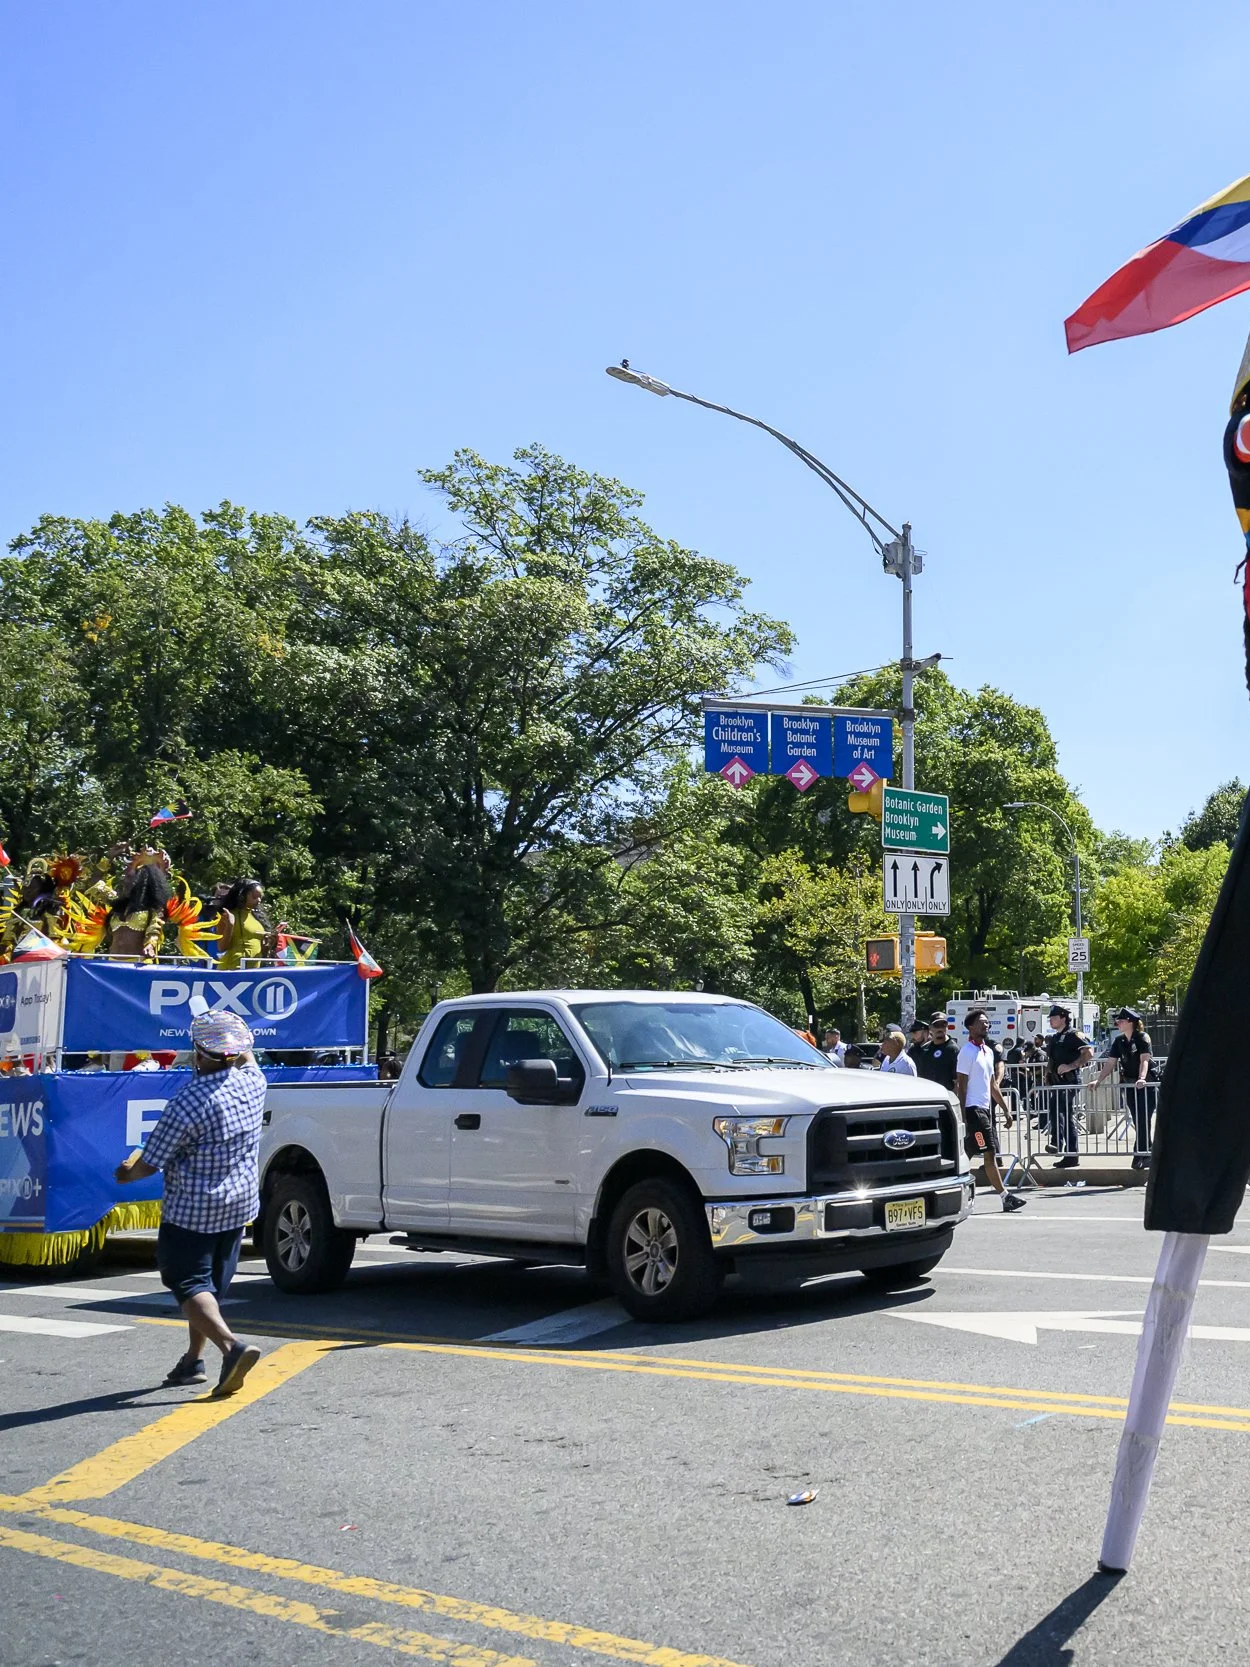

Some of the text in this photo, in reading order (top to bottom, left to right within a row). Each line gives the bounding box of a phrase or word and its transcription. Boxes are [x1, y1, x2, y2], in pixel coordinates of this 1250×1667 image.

[720, 715, 754, 728] Brooklyn
[783, 718, 819, 734] Brooklyn
[846, 721, 881, 735] Brooklyn
[713, 727, 761, 742] Children's
[787, 731, 816, 744] Botanic
[847, 734, 880, 746] Museum
[720, 743, 754, 754] Museum
[787, 745, 817, 757] Garden
[853, 748, 875, 759] of Art
[885, 796, 943, 815] Botanic Garden
[885, 811, 919, 828] Brooklyn
[885, 827, 917, 840] Museum
[886, 900, 905, 909] ONLY
[907, 901, 926, 910] ONLY
[928, 901, 946, 911] ONLY
[1071, 951, 1087, 961] 25
[160, 1028, 184, 1037] NEW
